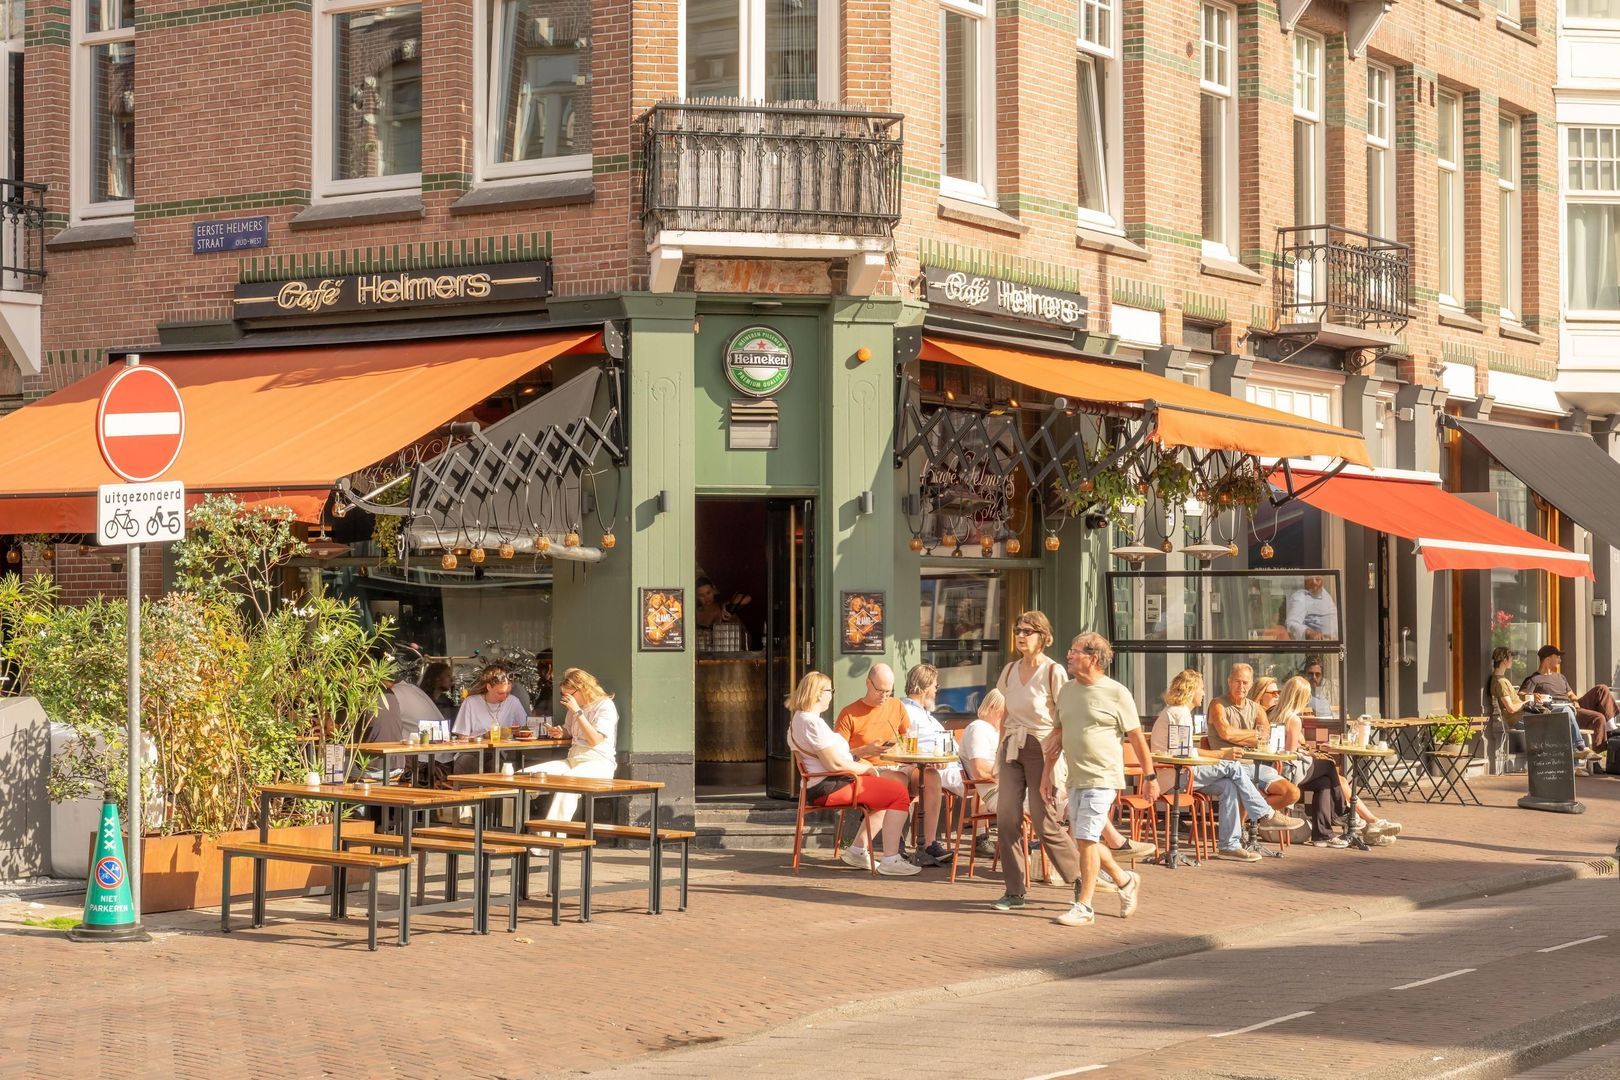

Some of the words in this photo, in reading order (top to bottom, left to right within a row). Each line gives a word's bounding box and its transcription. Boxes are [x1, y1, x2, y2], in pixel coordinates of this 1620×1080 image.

[197, 223, 224, 237] EERSTE
[226, 220, 263, 234] HELMERS
[197, 237, 224, 250] STRAAT
[235, 237, 262, 246] OUD-WEST
[277, 278, 345, 312] Café
[357, 272, 492, 305] Helmers
[996, 279, 1079, 323] Helmers
[734, 353, 787, 365] Heineken
[737, 371, 761, 388] PREMIUM
[762, 371, 784, 388] QUALITY
[105, 488, 181, 506] uitgezonderd
[100, 895, 119, 903] NIET
[89, 904, 129, 913] PARKEREN
